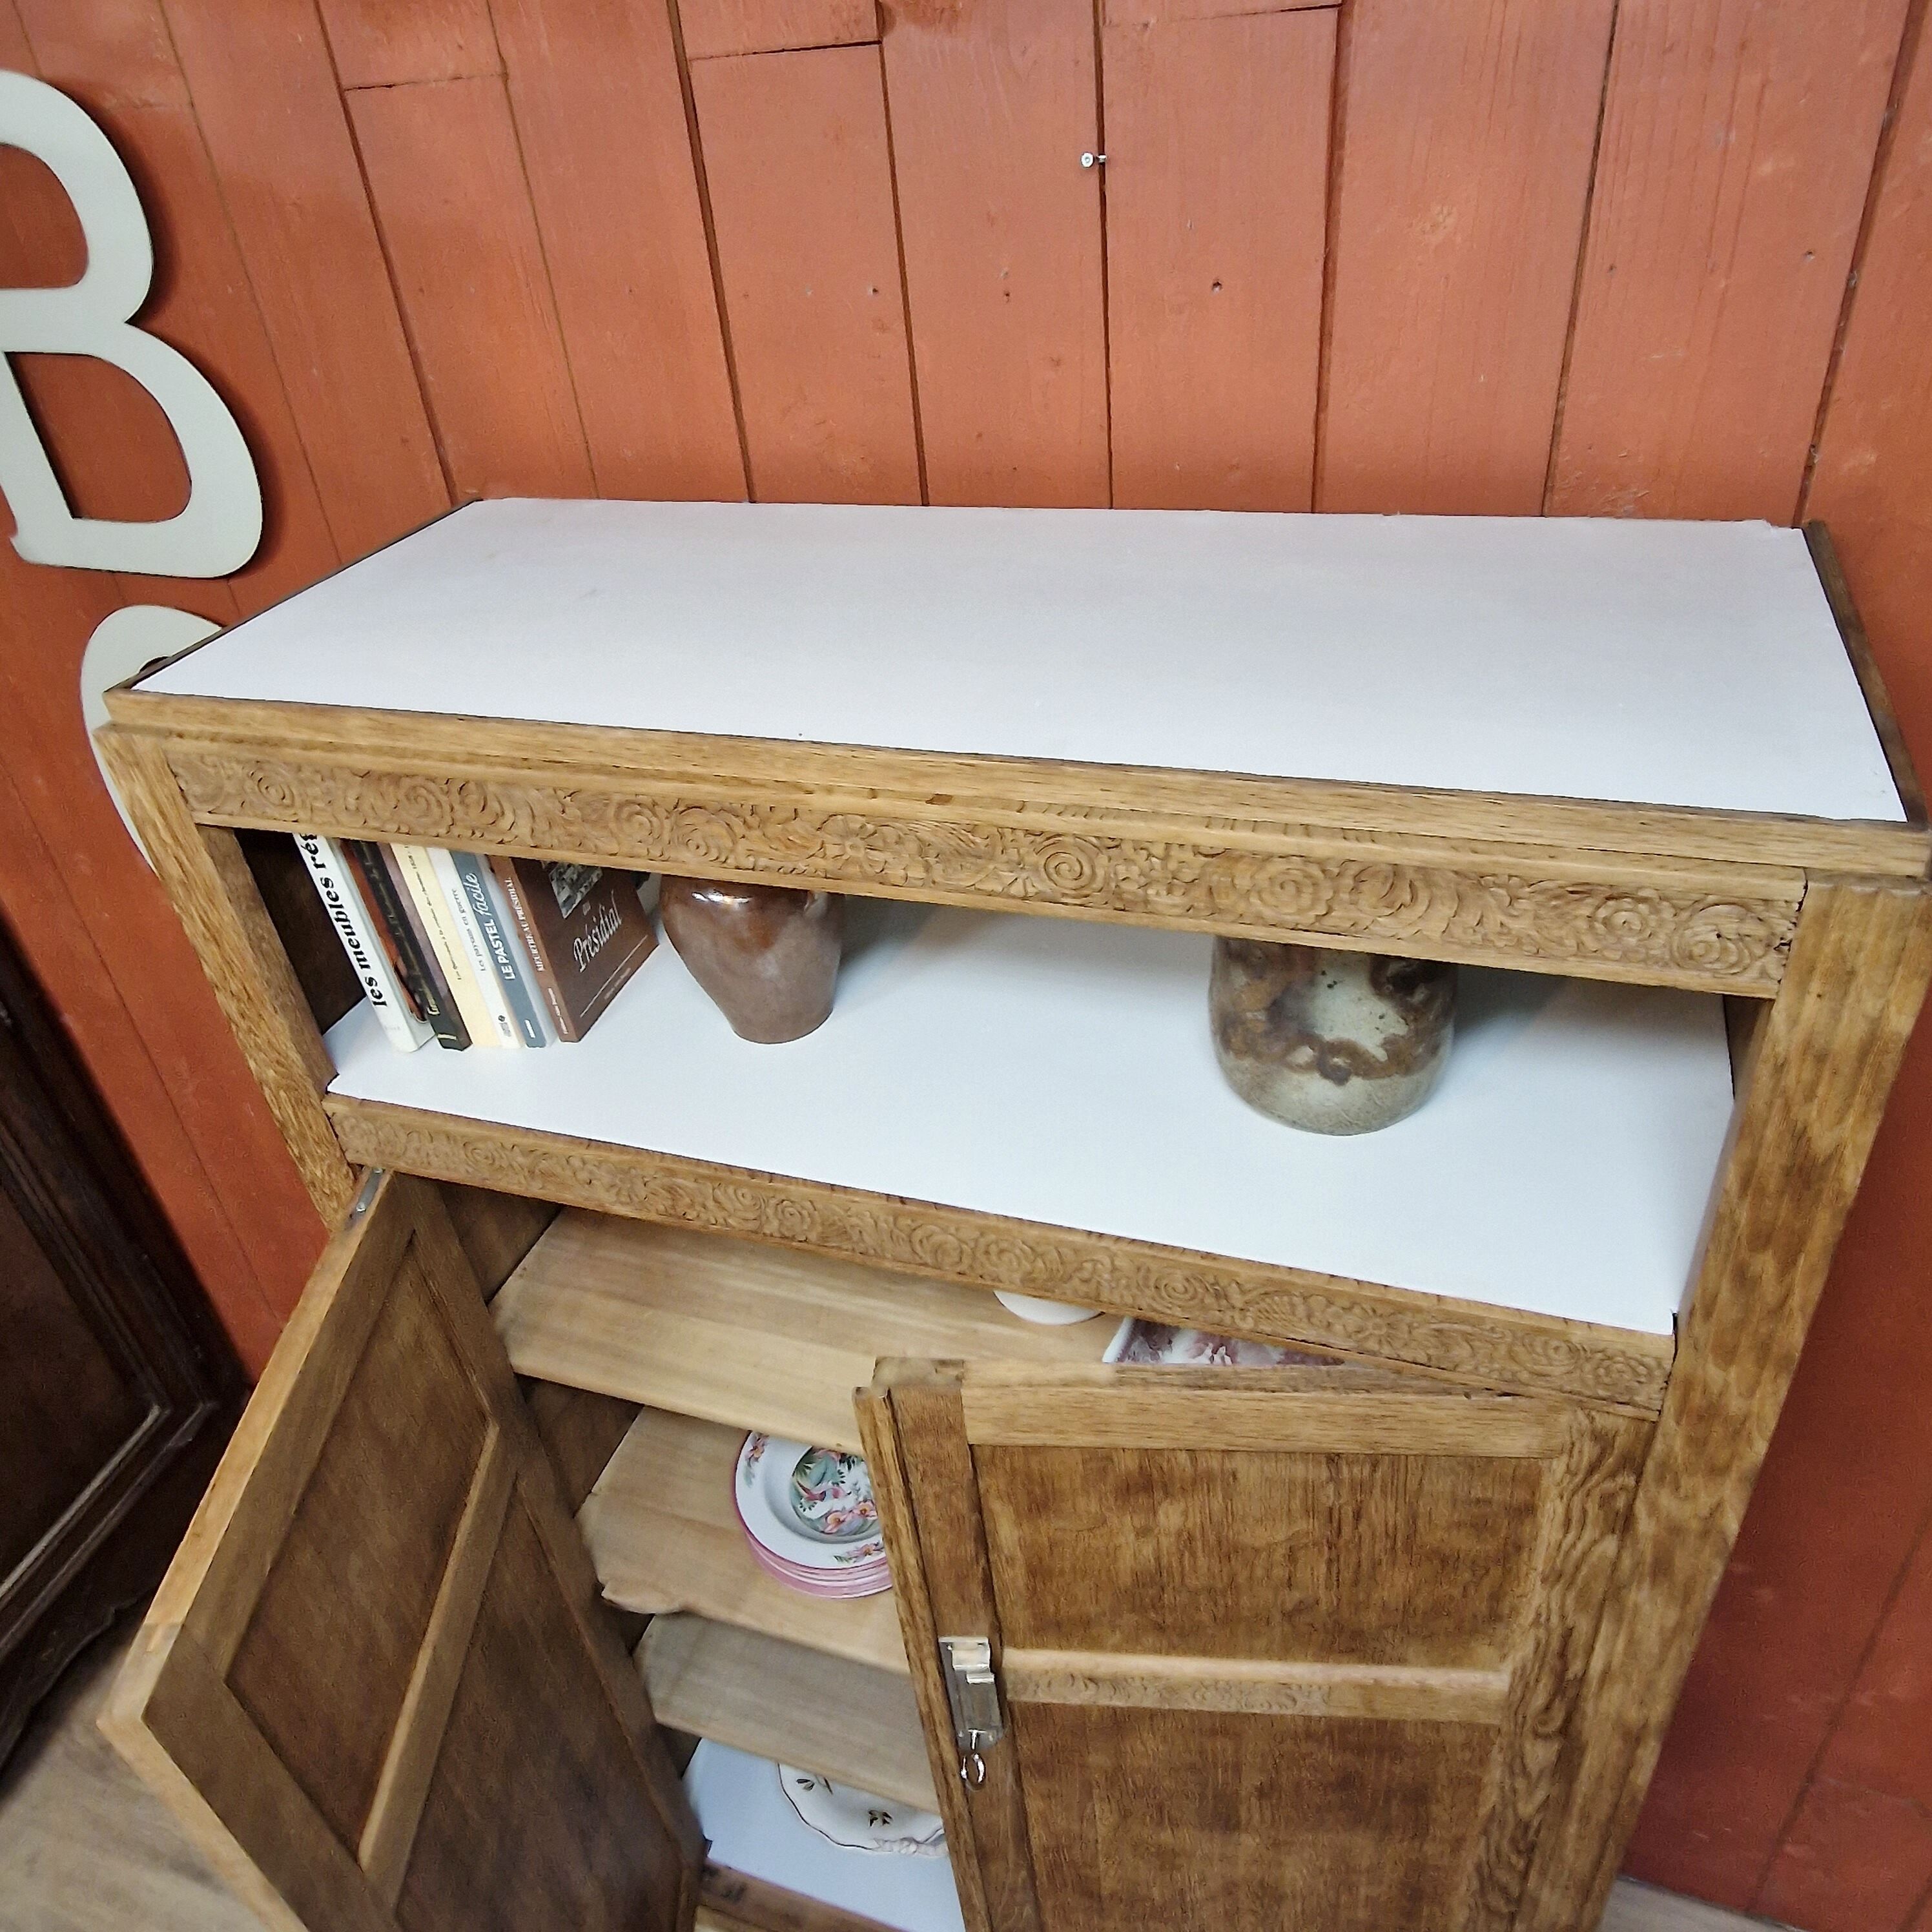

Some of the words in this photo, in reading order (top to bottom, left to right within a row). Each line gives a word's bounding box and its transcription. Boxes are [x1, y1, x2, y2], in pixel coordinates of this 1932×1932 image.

[0, 70, 263, 579] B
[462, 872, 493, 916] facile
[321, 877, 371, 970] meubles
[485, 918, 510, 964] PASTEL
[573, 889, 622, 973] Présidial
[365, 976, 387, 1006] les
[501, 965, 516, 980] LE
